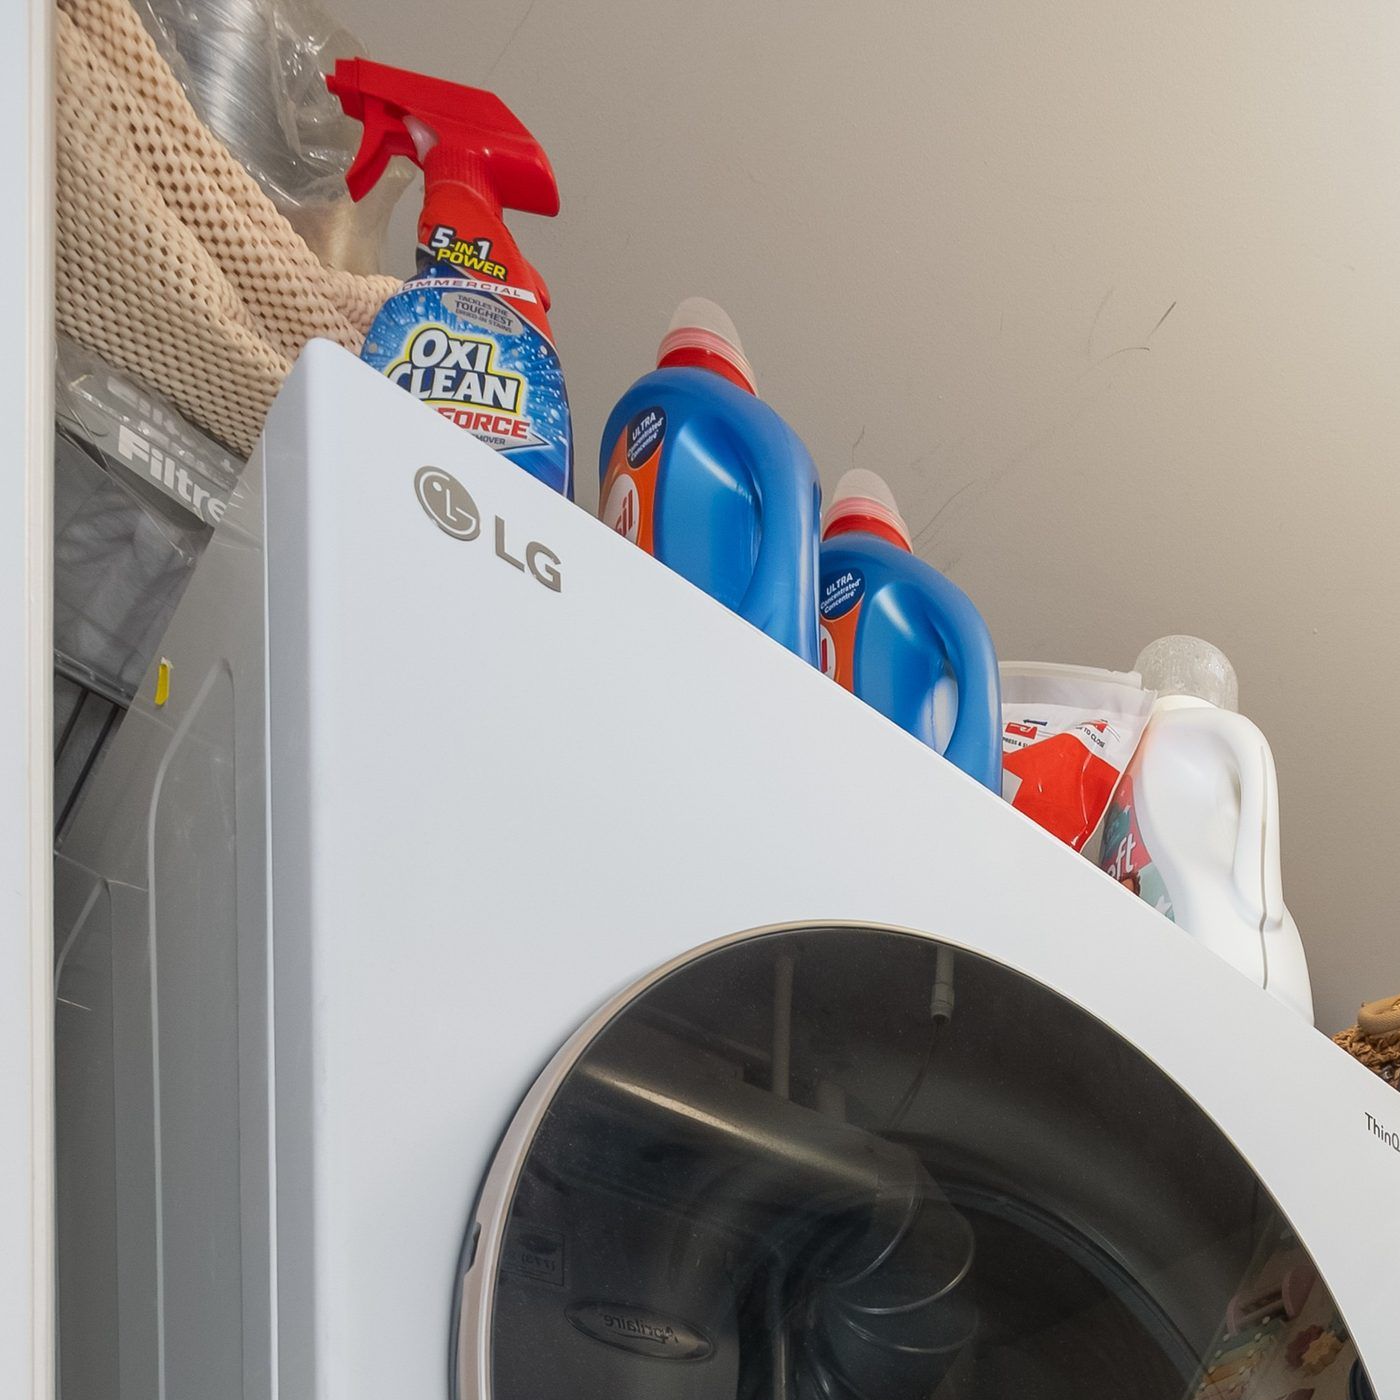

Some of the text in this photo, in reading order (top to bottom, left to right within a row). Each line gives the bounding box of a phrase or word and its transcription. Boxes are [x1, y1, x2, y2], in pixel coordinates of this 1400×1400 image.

[430, 226, 491, 260] 5-IN-1
[437, 248, 506, 280] POWER
[401, 279, 521, 297] OMMERCIAL
[455, 301, 513, 327] TOUGHEST
[411, 329, 491, 372] OXI
[632, 411, 657, 441] ULTRA
[495, 514, 562, 593] LG
[826, 572, 854, 596] ULTRA
[1364, 1111, 1400, 1153] ThinQ
